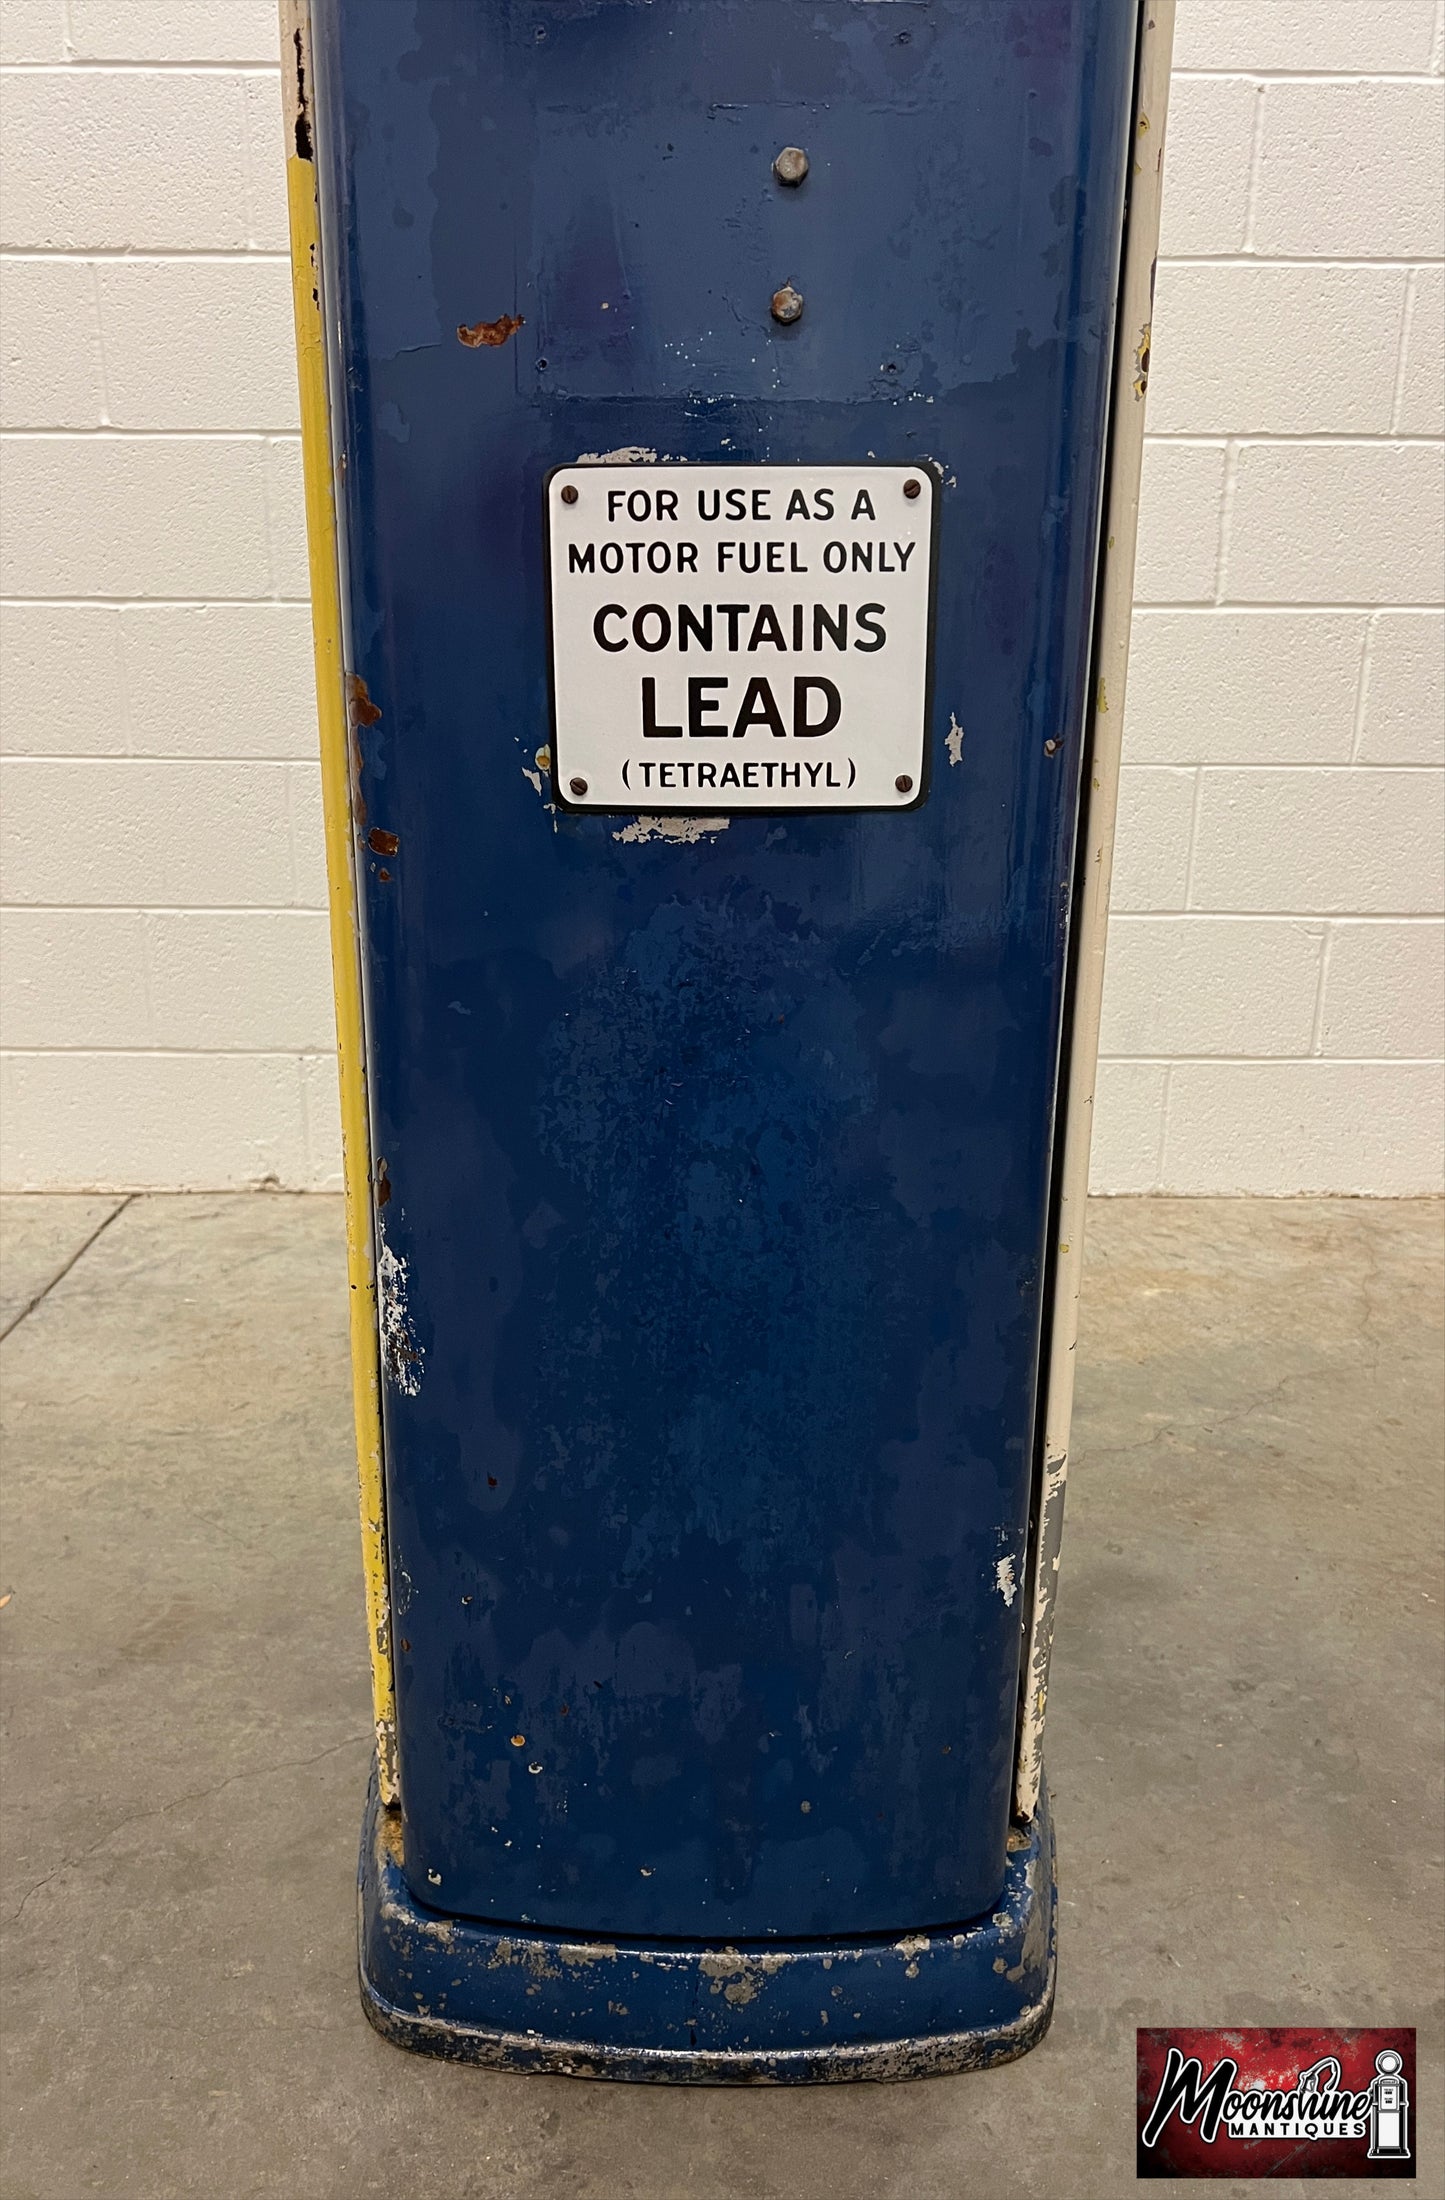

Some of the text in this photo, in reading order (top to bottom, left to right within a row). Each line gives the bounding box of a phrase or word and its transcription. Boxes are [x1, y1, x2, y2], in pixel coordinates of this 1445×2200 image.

[608, 489, 875, 522] FOR USE AS A
[569, 542, 915, 573] MOTOR FUEL ONLY
[594, 603, 886, 652] CONTAINS
[642, 677, 841, 737] LEAD
[622, 758, 855, 790] (TETRAETHYL)
